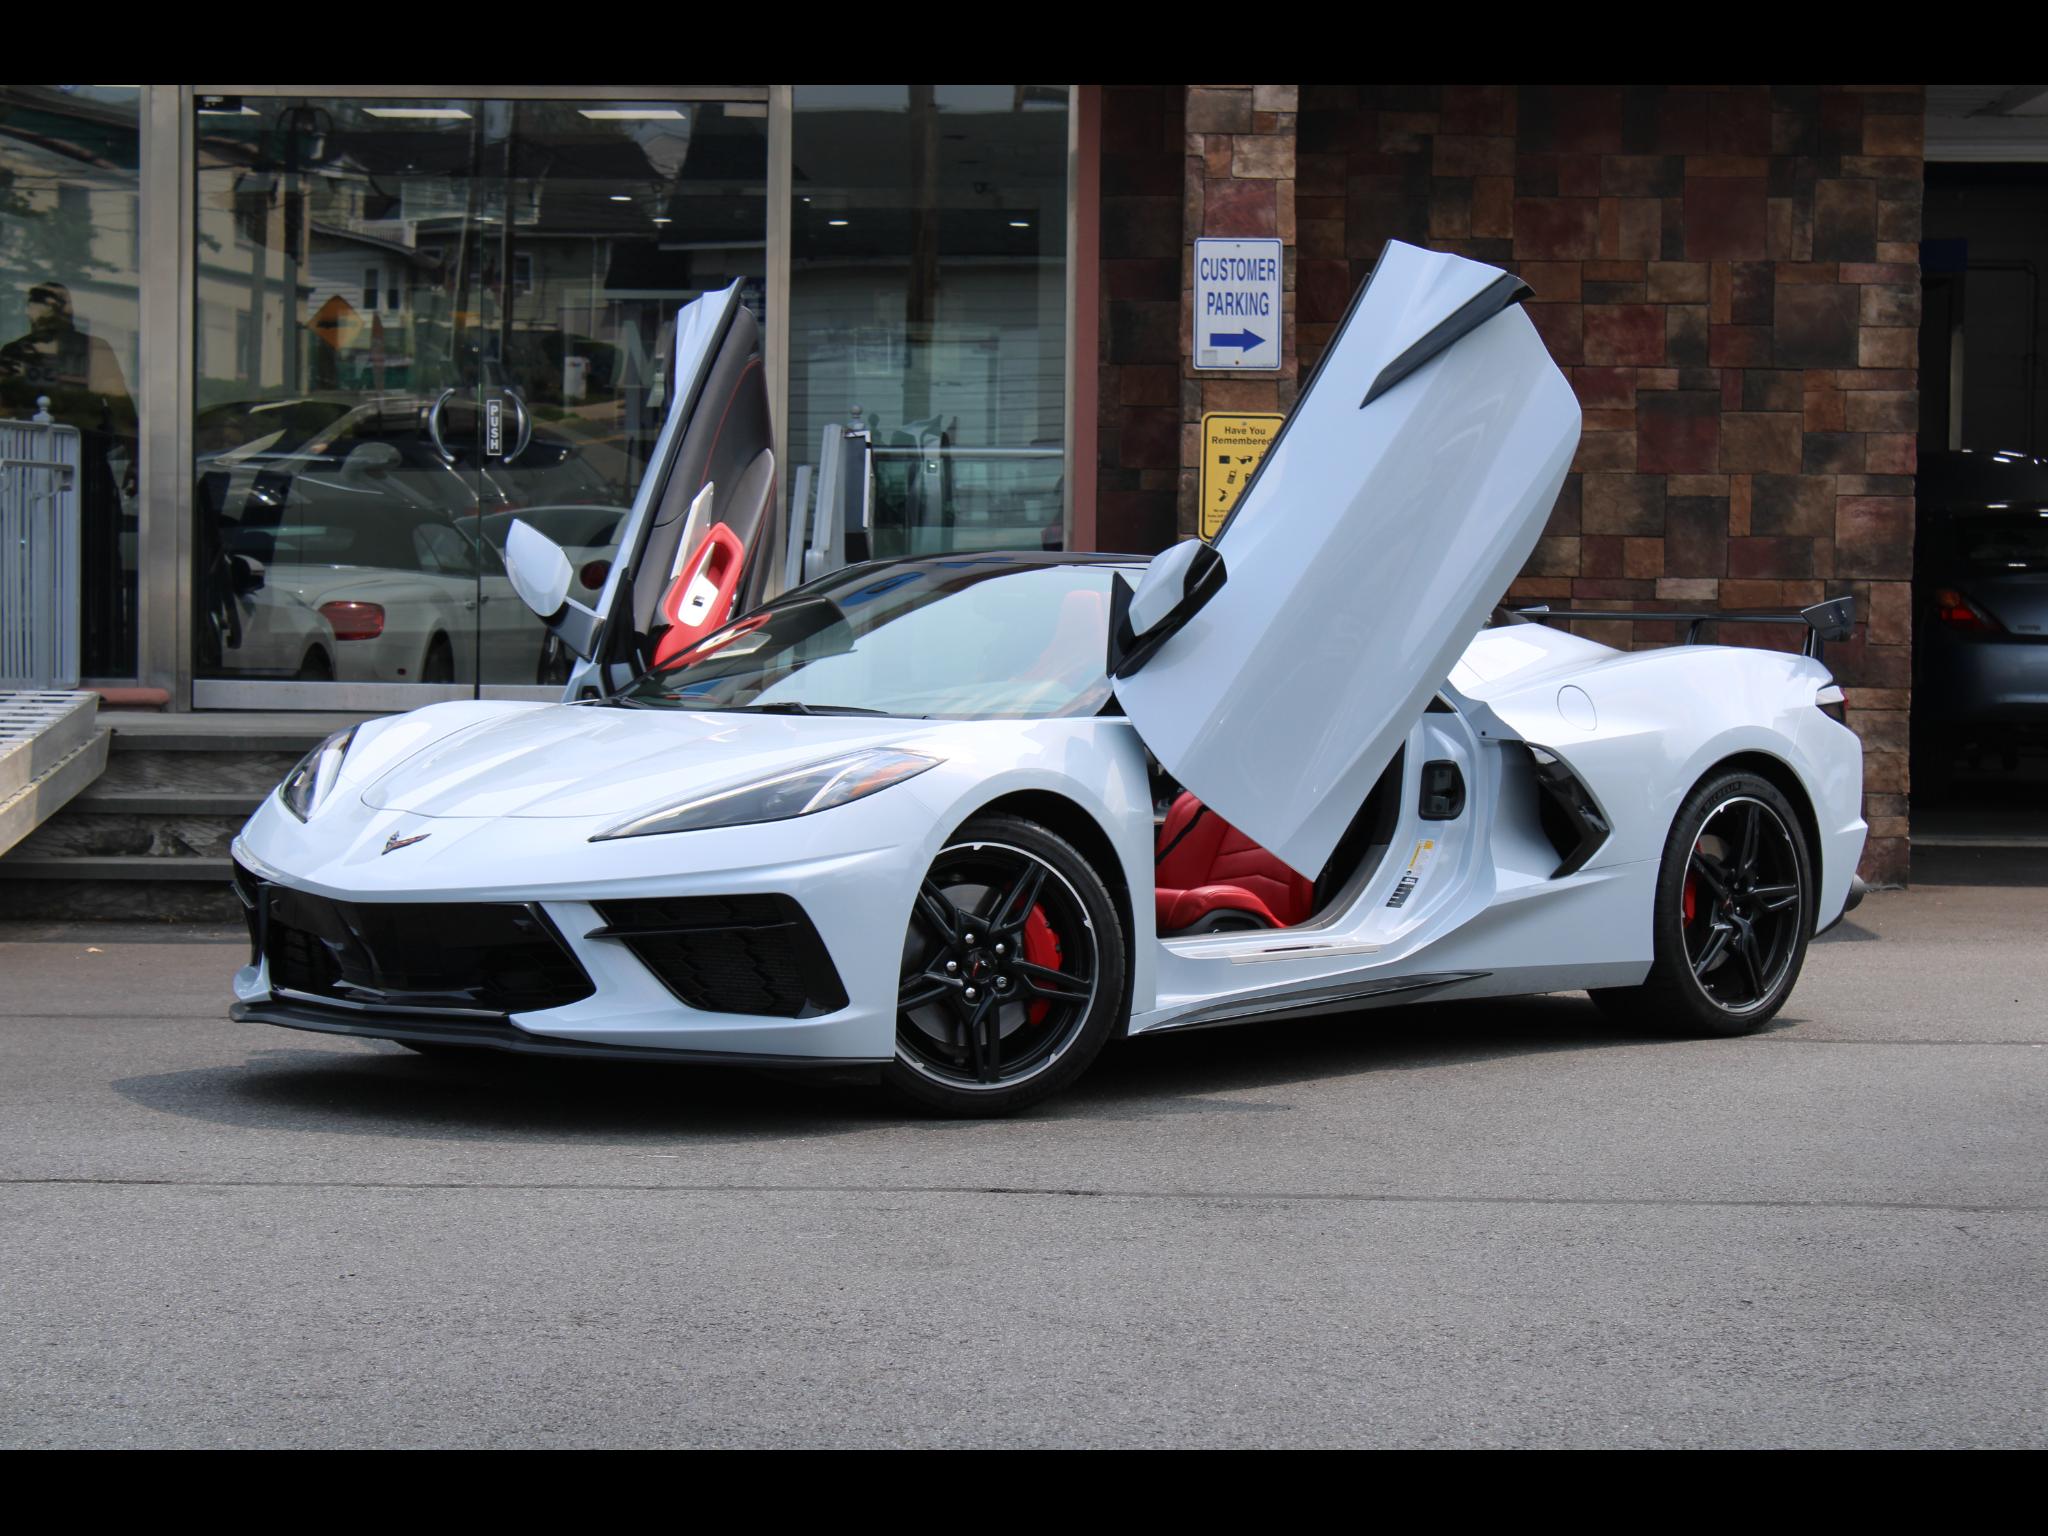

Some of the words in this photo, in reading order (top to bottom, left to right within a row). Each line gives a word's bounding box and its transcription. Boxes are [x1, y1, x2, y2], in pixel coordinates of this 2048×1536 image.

[1200, 258, 1276, 281] CUSTOMER
[1207, 292, 1269, 316] PARKING
[490, 405, 499, 450] PUSH
[1224, 426, 1247, 435] Have
[1249, 426, 1266, 435] You
